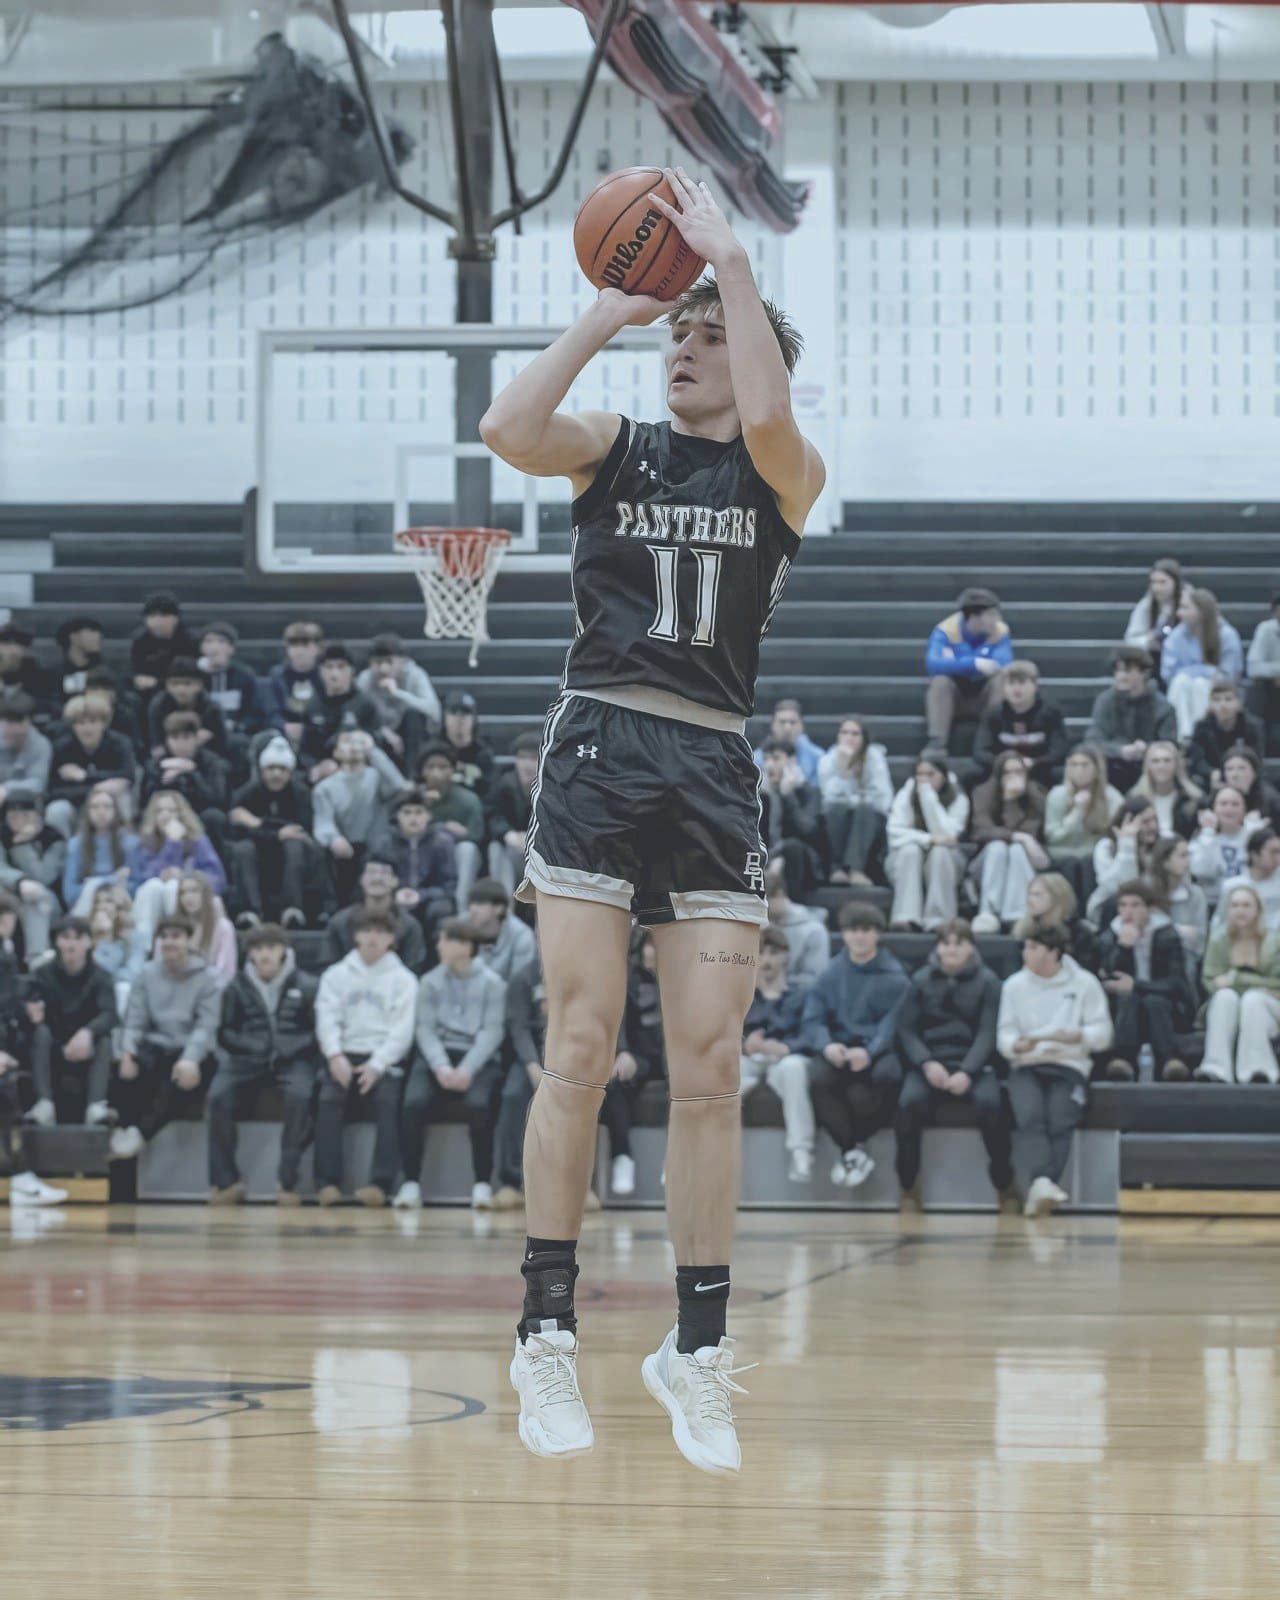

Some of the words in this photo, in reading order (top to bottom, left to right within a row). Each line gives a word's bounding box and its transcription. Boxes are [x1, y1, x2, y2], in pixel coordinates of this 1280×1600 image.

[600, 209, 662, 291] Wilson
[614, 501, 757, 548] PANTHERS
[645, 544, 722, 647] 11
